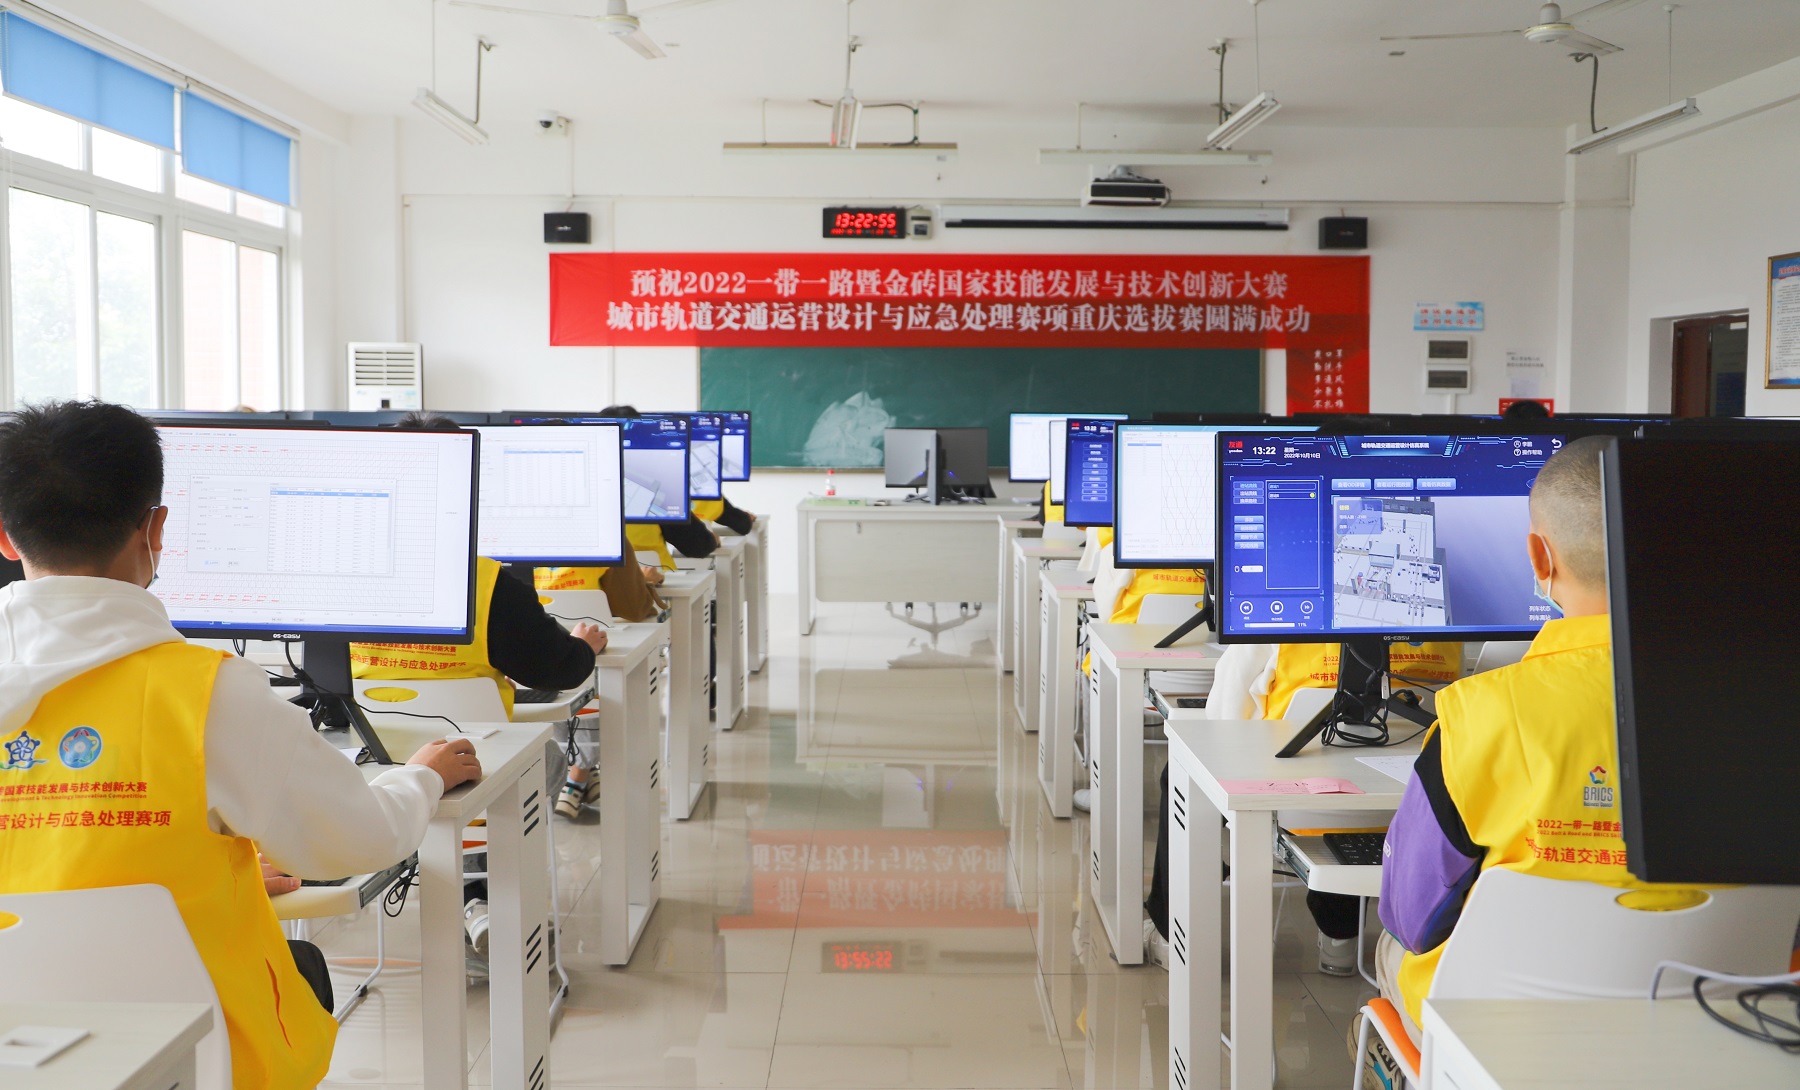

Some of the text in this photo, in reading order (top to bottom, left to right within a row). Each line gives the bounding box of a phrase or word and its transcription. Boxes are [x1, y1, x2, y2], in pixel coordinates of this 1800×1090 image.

[834, 212, 896, 229] 13:22:55
[630, 268, 1288, 299] 预祝2022一带一路暨金砖国家技能发展与技术创新大赛
[606, 301, 1311, 333] 城市轨道交通运营设计与应急处理赛项重庆选拔赛圆满成功
[1252, 447, 1276, 455] 13:22
[1583, 786, 1613, 801] BRICS
[0, 810, 171, 830] 营设计与应急处理赛项
